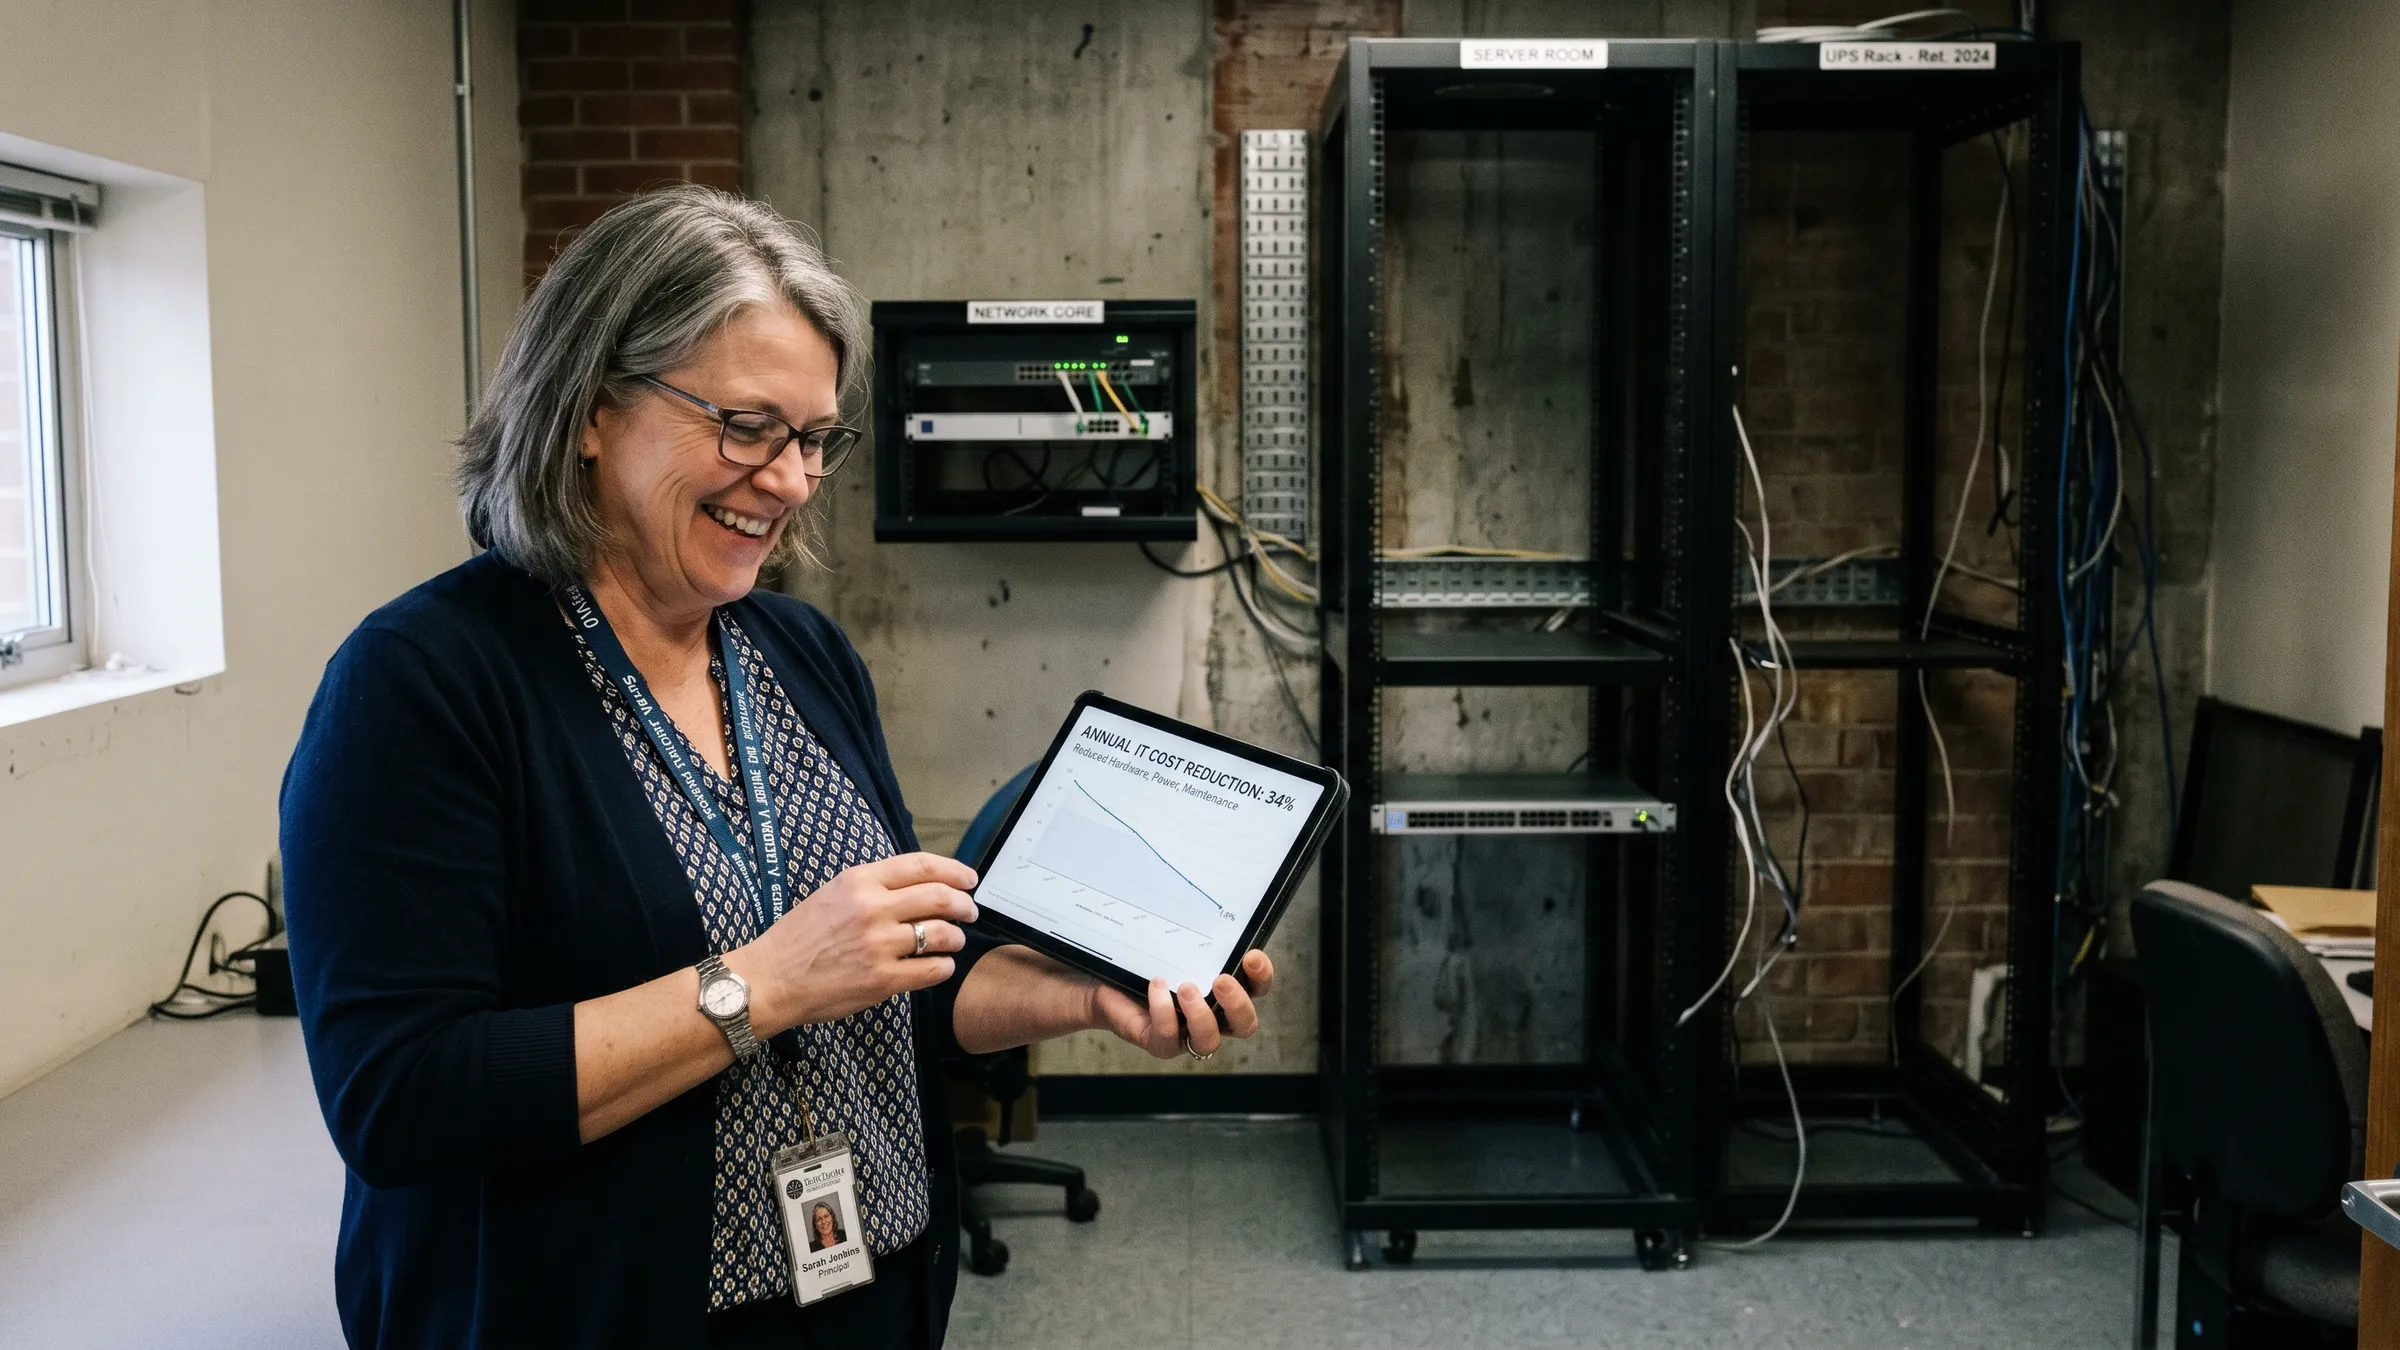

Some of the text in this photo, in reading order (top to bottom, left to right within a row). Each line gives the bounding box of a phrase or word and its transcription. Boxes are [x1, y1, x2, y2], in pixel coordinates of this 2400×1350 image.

[1473, 48, 1594, 61] SERVER ROOM
[1825, 49, 1858, 62] UPS
[1863, 49, 1902, 62] Rack
[1953, 49, 1989, 62] 2024
[973, 306, 1095, 318] NETWORK CORE
[1081, 725, 1296, 812] ANNUAL IT COST REDUCTION: 34%
[1073, 743, 1239, 811] Reduced Hardware, Power, Maintenance
[802, 1258, 827, 1272] Sarah
[818, 1261, 850, 1278] Principal
